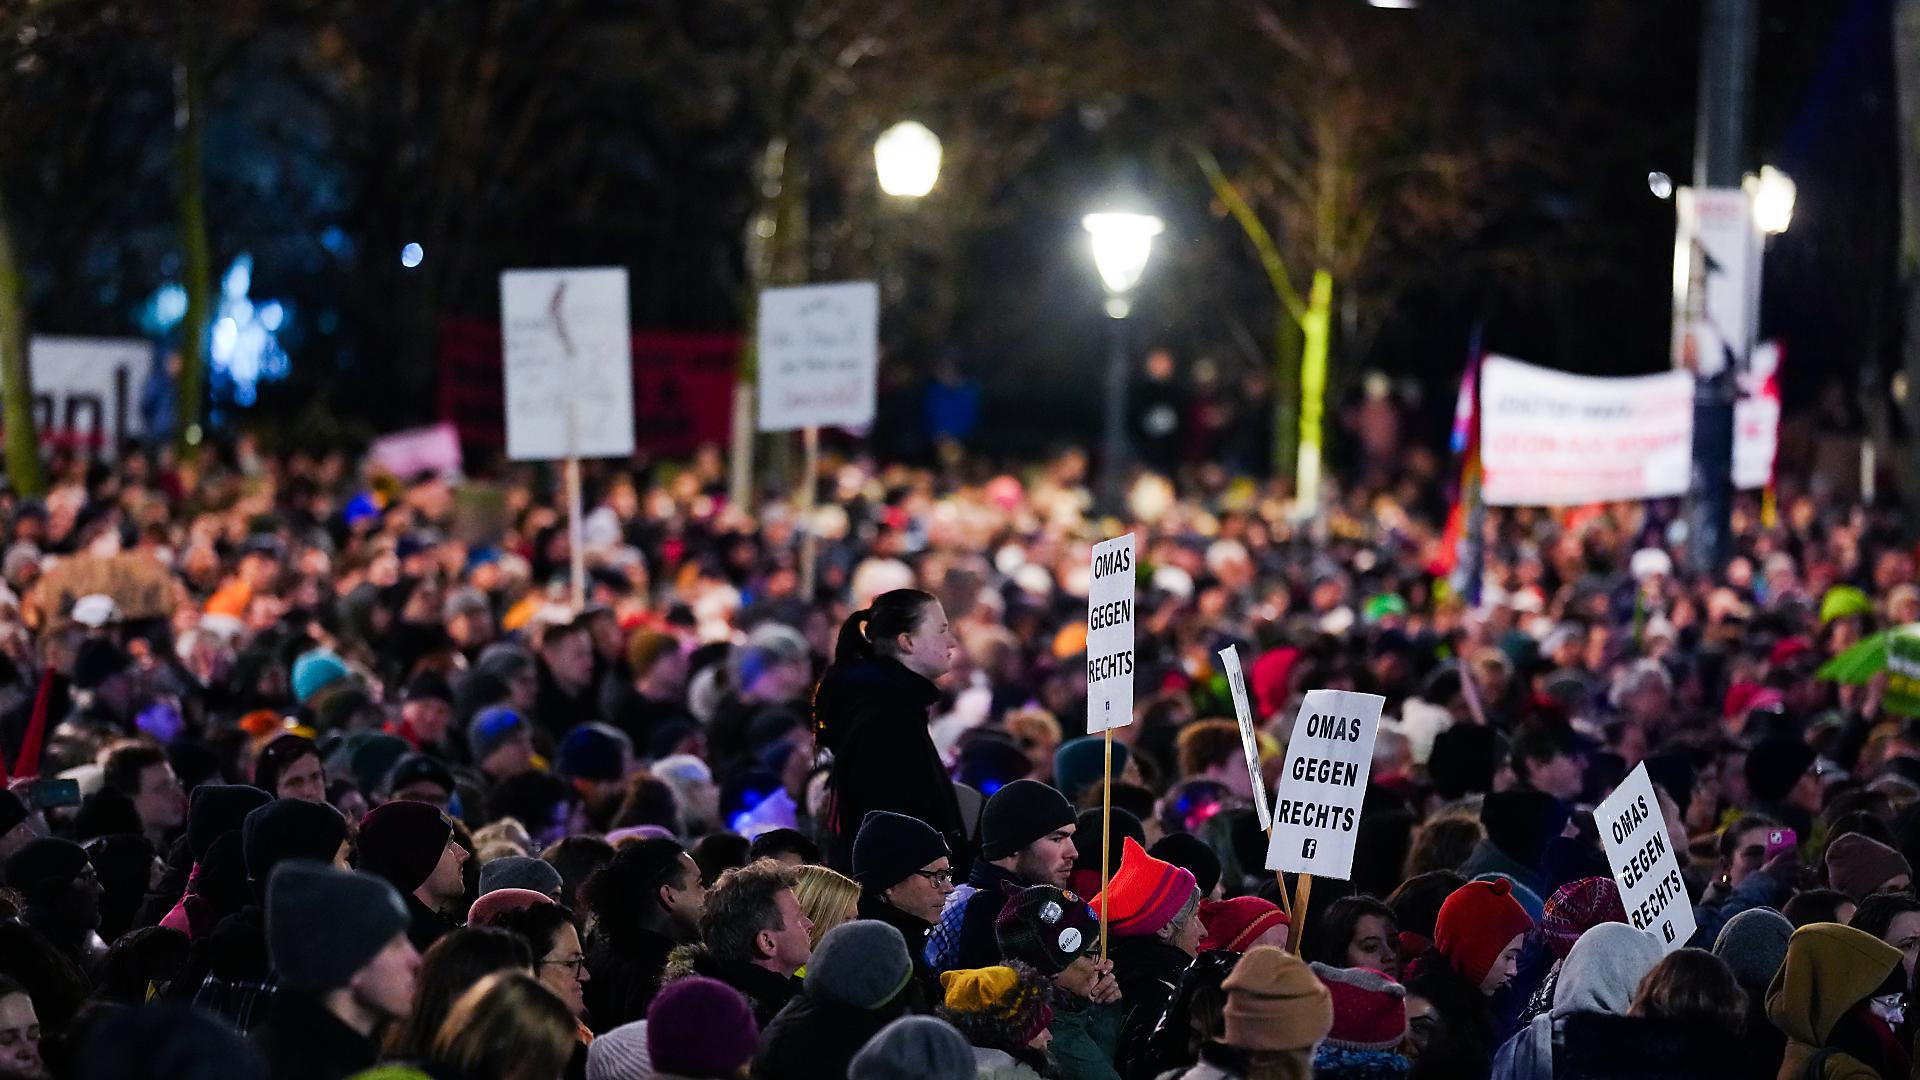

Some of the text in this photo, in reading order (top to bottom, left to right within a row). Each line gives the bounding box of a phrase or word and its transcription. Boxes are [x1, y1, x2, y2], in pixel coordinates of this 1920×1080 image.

[1094, 547, 1130, 579] OMAS
[1091, 598, 1131, 631] GEGEN
[1088, 650, 1133, 683] RECHTS
[1306, 713, 1361, 742] OMAS
[1292, 756, 1359, 787] GEGEN
[1278, 800, 1355, 832] RECHTS
[1612, 794, 1649, 845] OMAS
[1622, 831, 1666, 889] GEGEN
[1631, 869, 1681, 931] RECHTS
